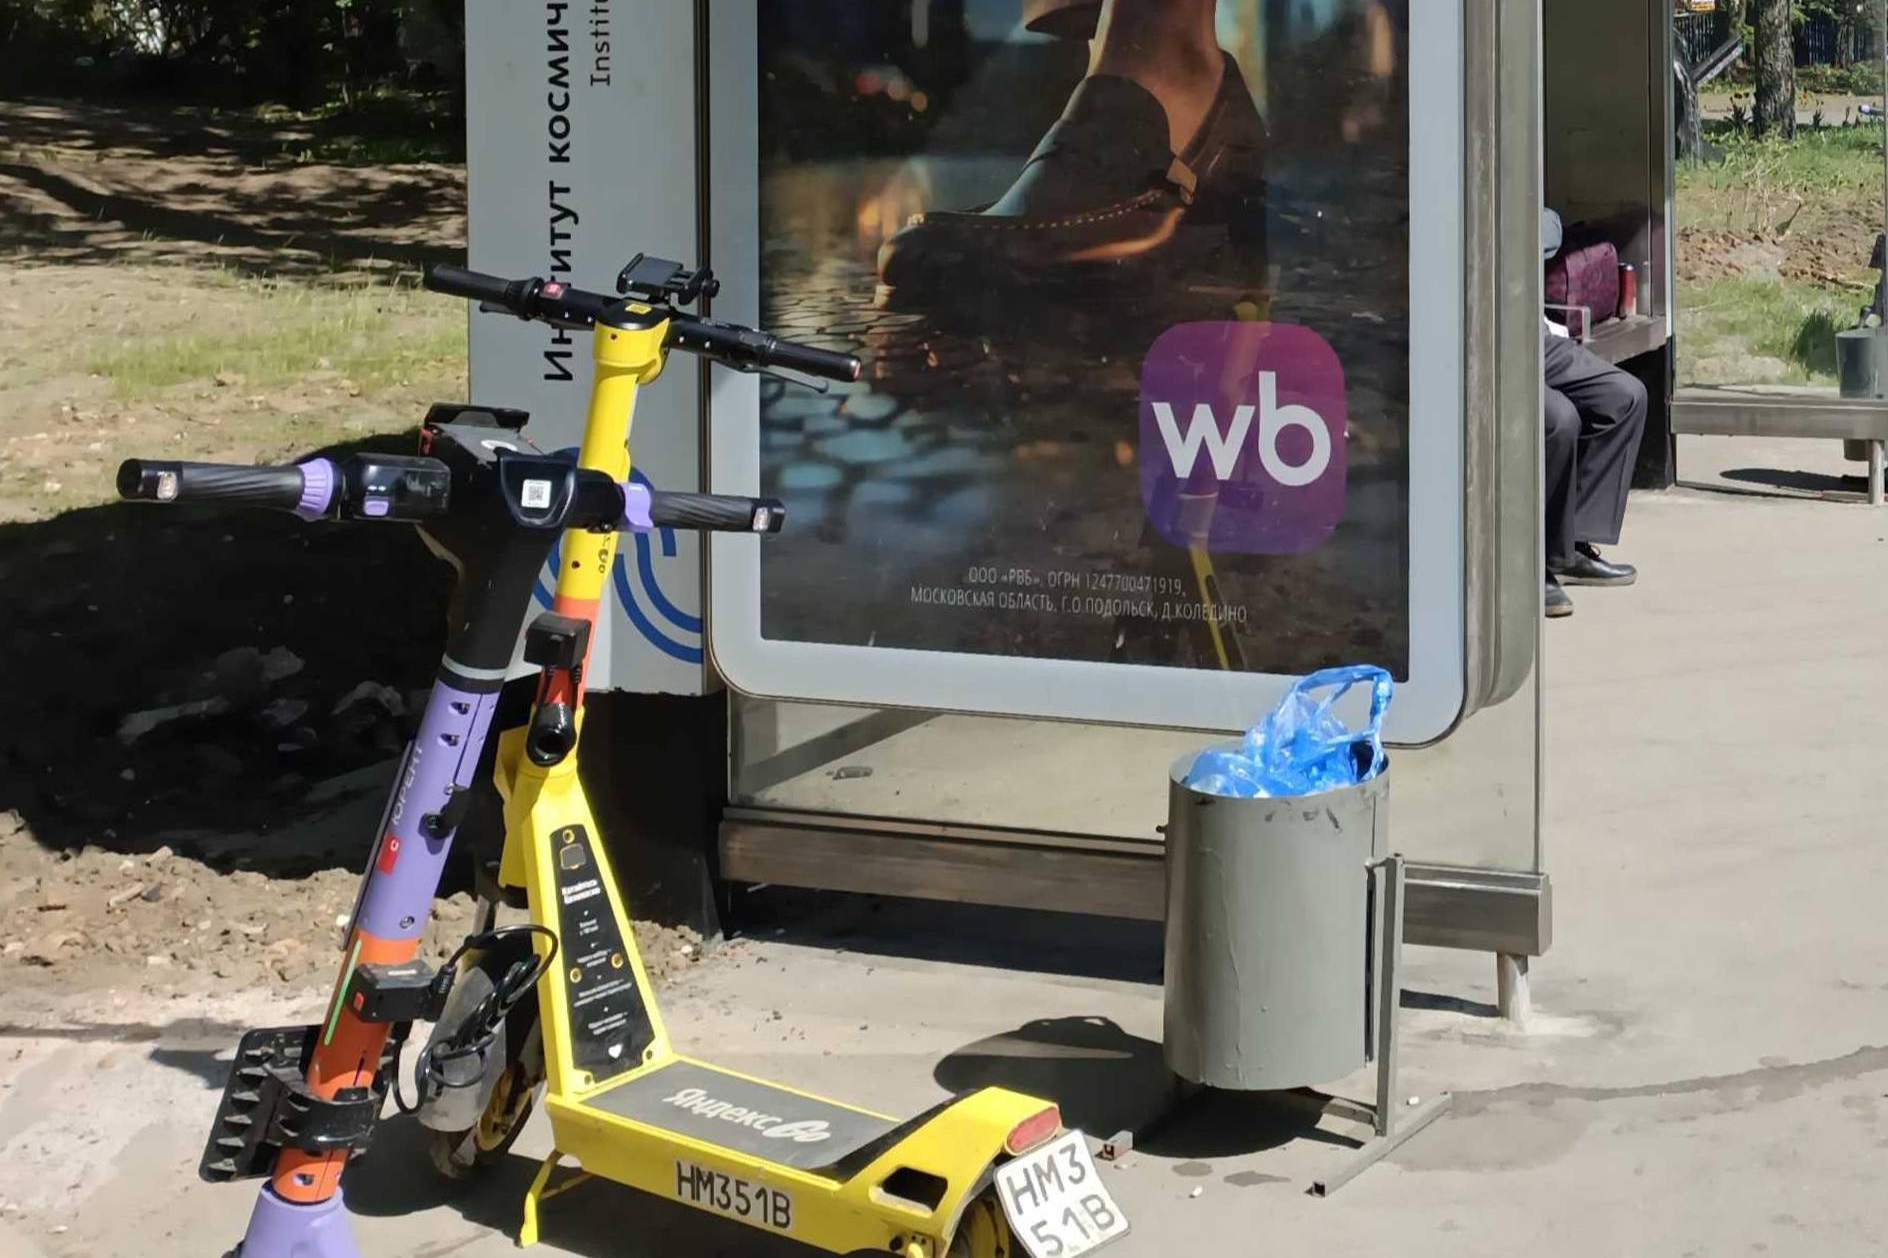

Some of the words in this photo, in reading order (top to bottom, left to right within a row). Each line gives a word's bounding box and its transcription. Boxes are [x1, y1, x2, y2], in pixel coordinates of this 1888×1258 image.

[544, 181, 579, 381] Инитут
[1151, 370, 1332, 488] wb
[910, 586, 995, 607] МОСКОВСКАЯ
[968, 566, 998, 584] ООО
[1047, 570, 1080, 588] ОГРН
[391, 745, 423, 825] ЮРЕНТ
[661, 1088, 783, 1130] Яндекс
[676, 1160, 792, 1230] НМ351В
